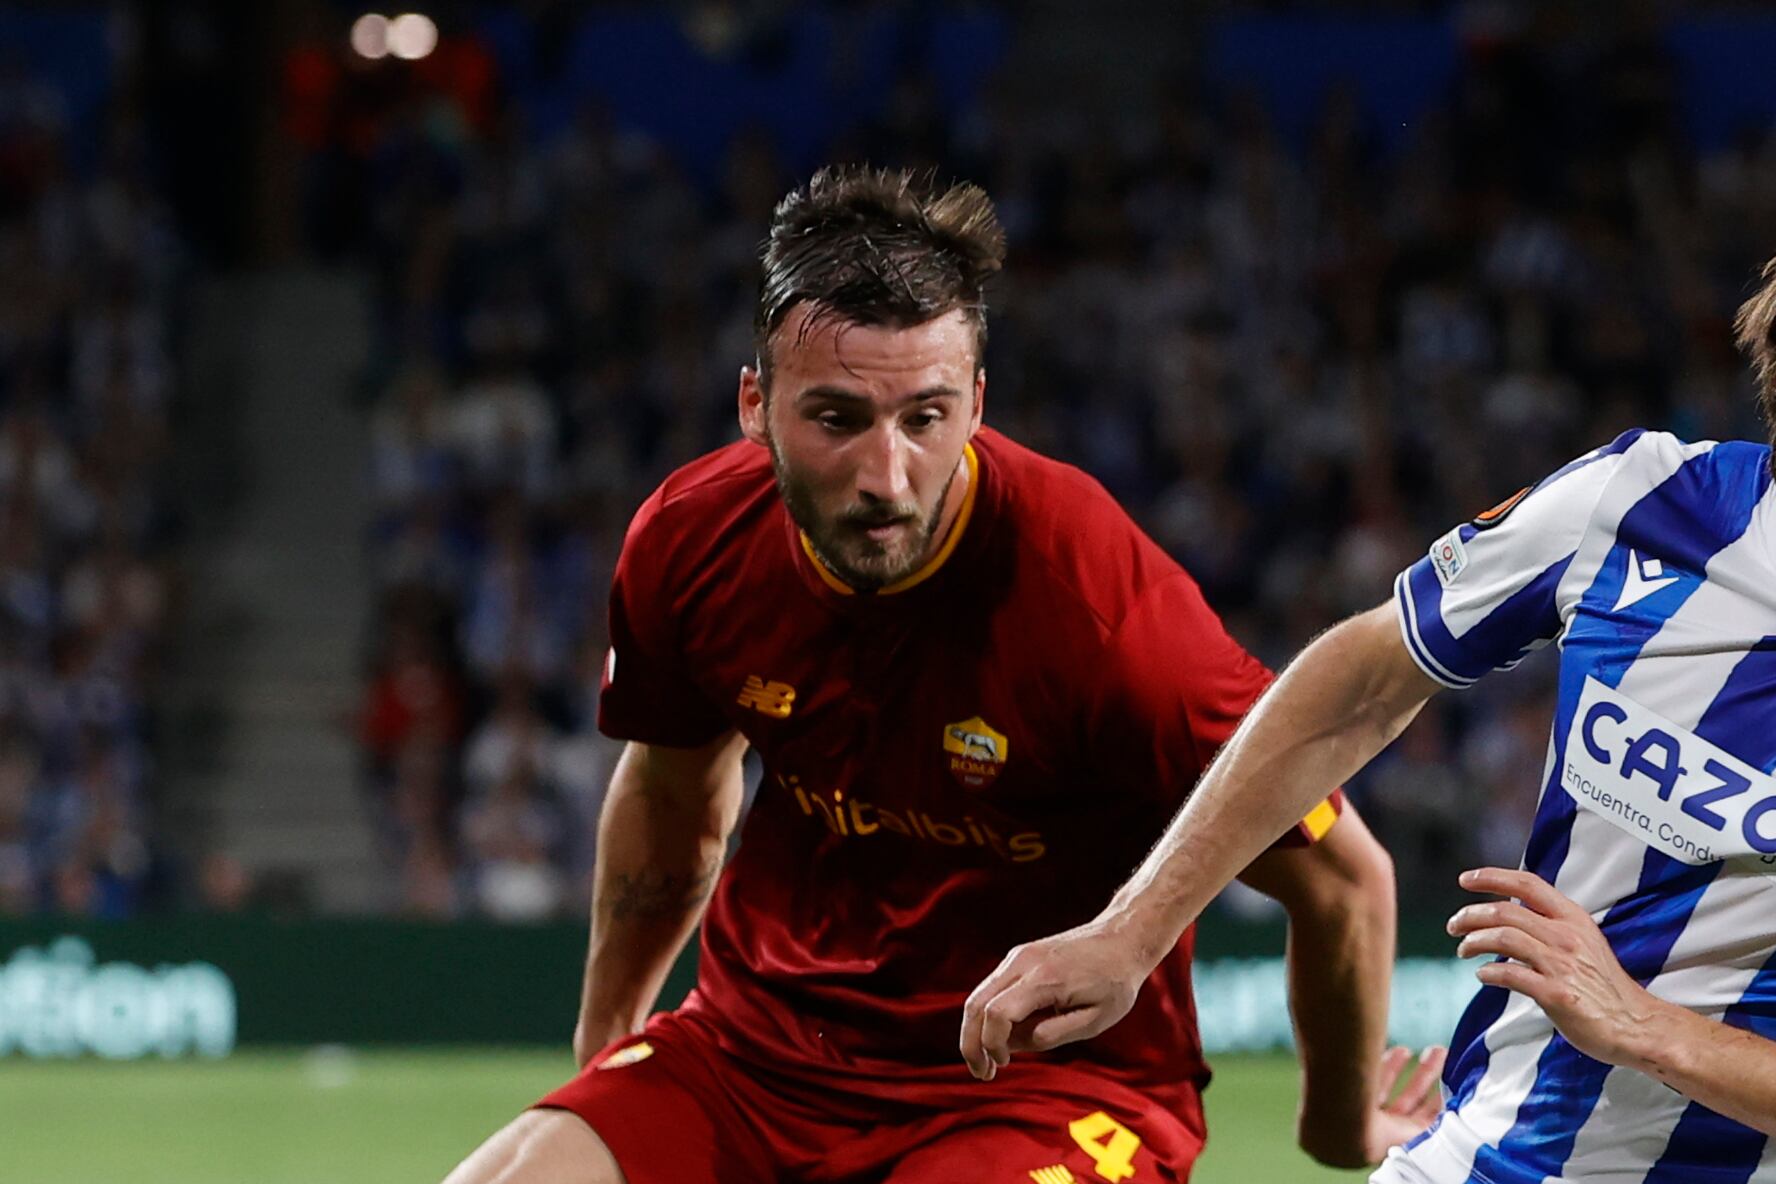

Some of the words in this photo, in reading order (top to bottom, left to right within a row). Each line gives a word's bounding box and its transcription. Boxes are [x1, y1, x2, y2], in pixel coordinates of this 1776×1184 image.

[951, 757, 997, 776] ROMA
[1566, 763, 1654, 834] Encuentra.
[1657, 822, 1725, 863] Cond
[1067, 1109, 1142, 1184] 4
